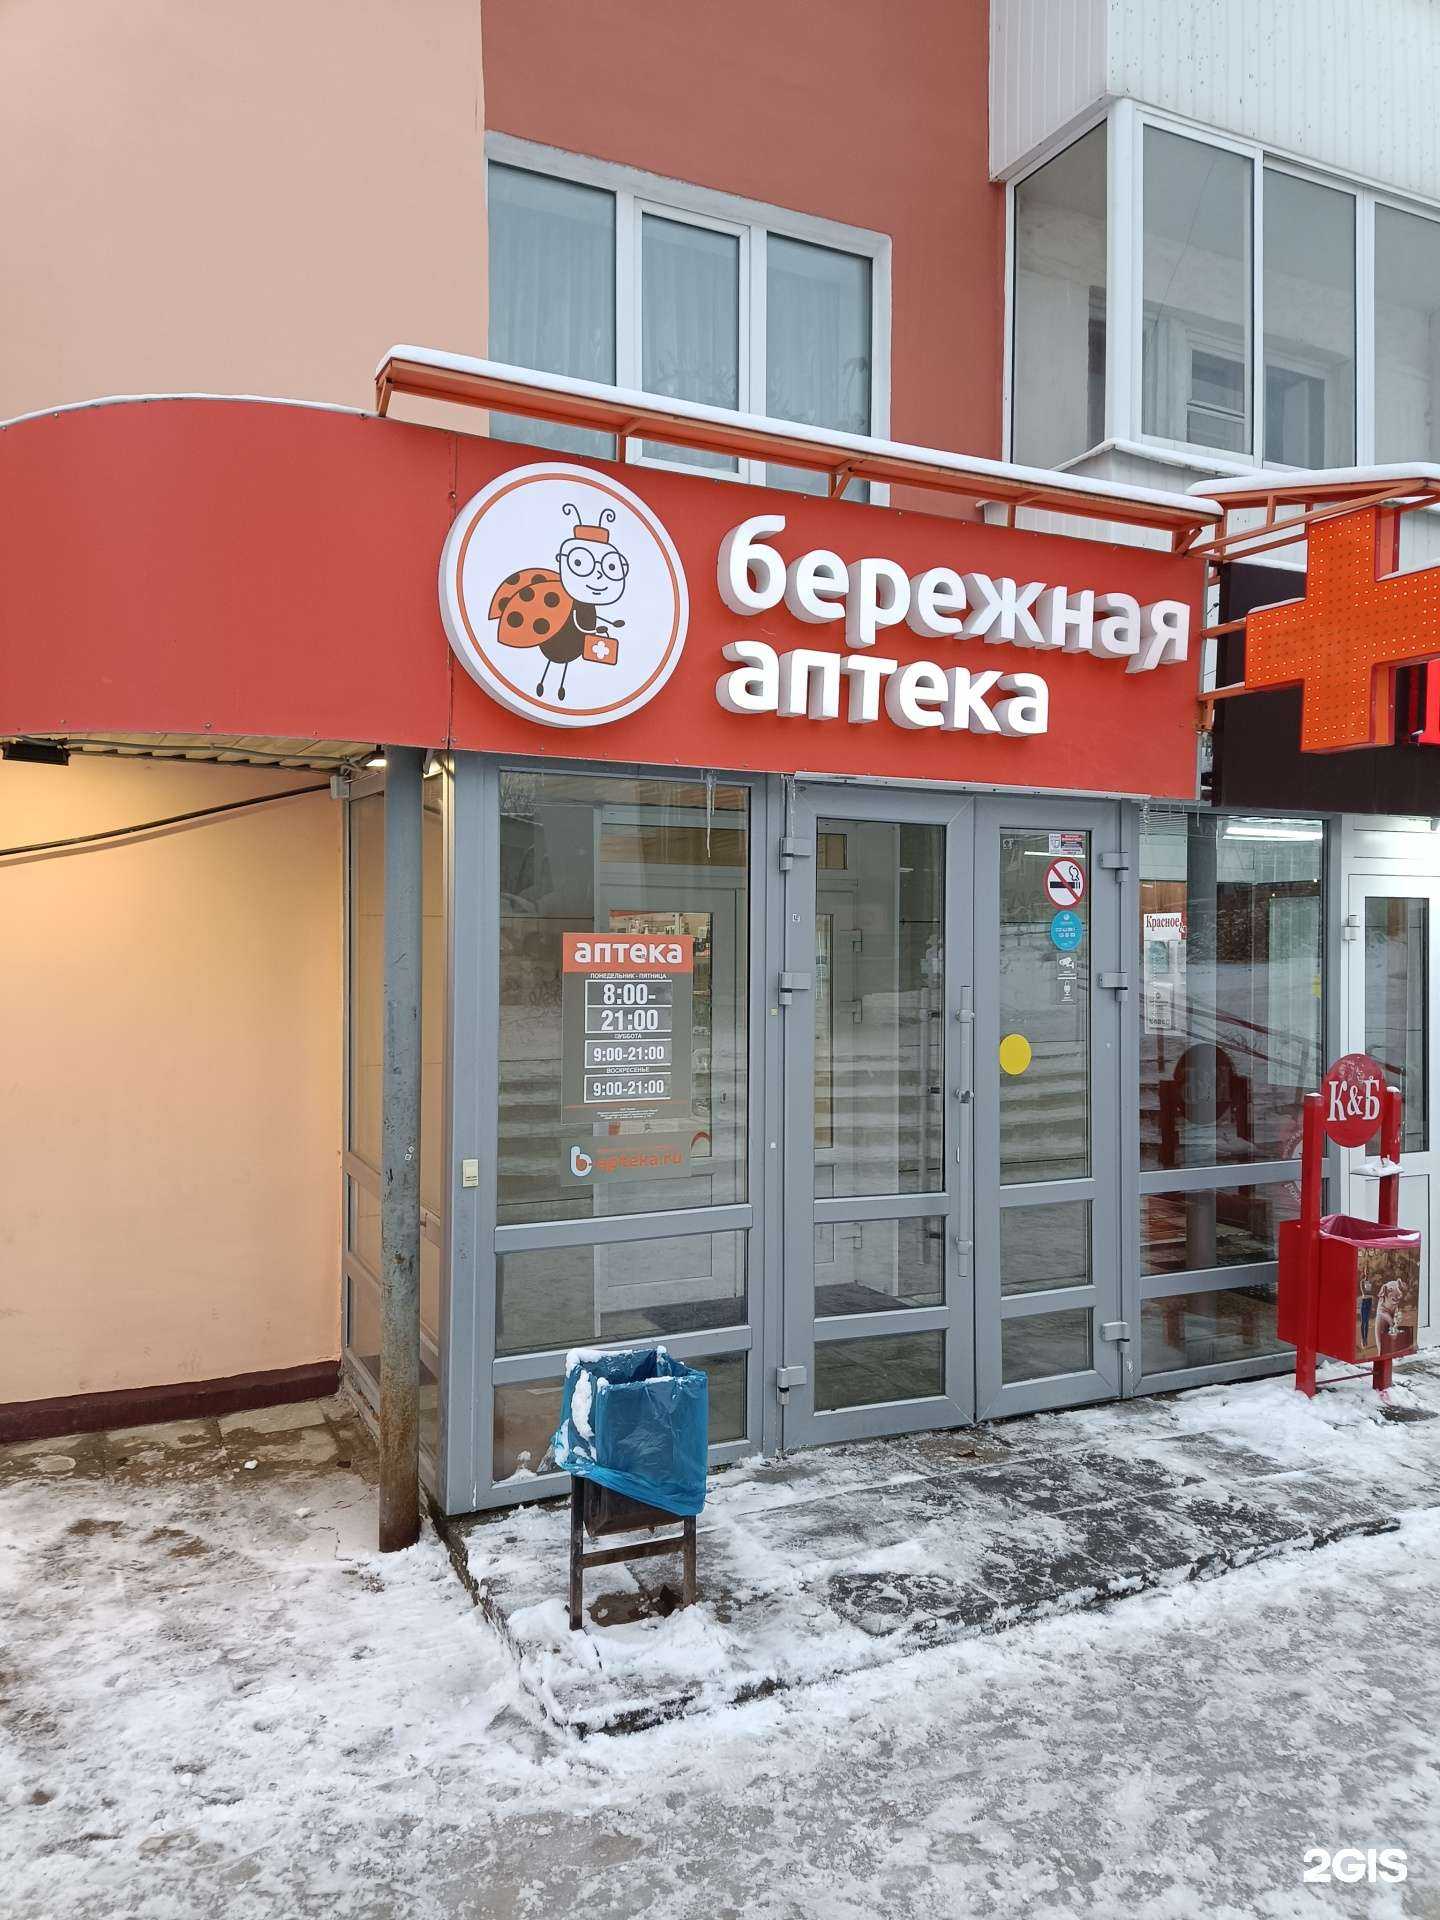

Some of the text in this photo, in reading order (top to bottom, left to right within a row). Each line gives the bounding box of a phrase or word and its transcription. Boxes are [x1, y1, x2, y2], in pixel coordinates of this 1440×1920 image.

[717, 515, 1191, 673] бережная
[716, 640, 1049, 737] аптека
[574, 942, 683, 964] аптека
[603, 983, 656, 1005] 8:00-
[601, 1009, 658, 1031] 21:00
[593, 1046, 665, 1062] 9:00-21:00
[593, 1079, 665, 1096] 9:00-21:00
[1327, 1077, 1381, 1122] К&Б
